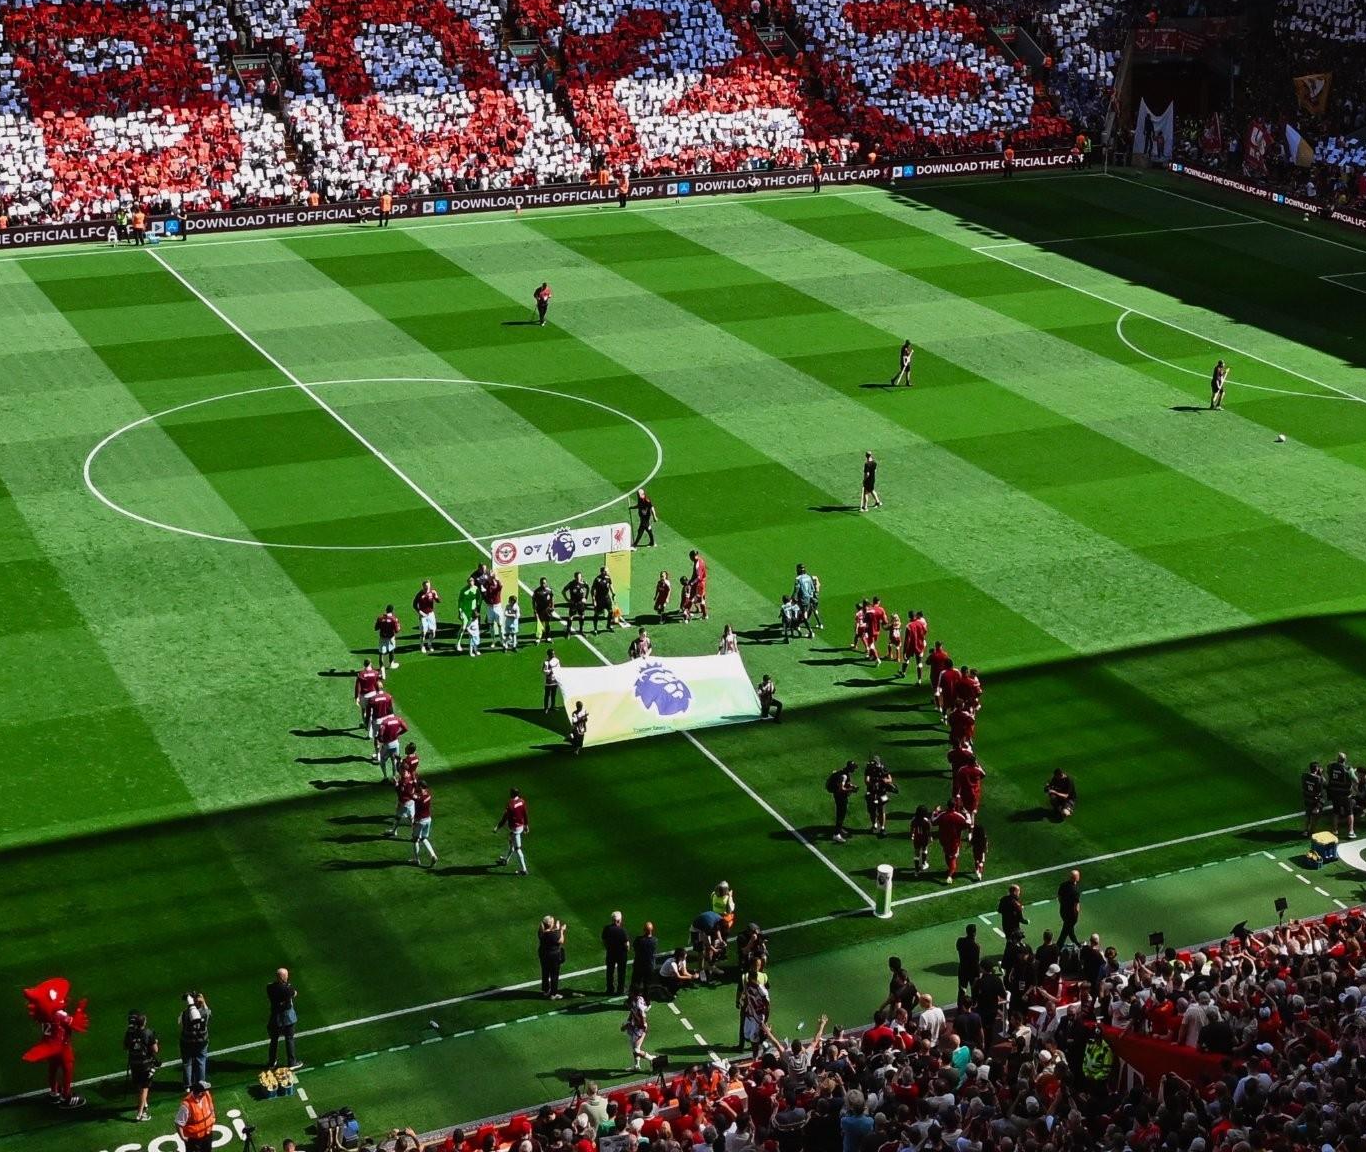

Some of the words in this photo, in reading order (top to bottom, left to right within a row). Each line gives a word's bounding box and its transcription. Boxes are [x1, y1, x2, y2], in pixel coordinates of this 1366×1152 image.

[916, 160, 982, 176] DOWNLOAD
[985, 159, 999, 170] THE
[1048, 154, 1064, 165] LFC
[764, 175, 791, 187] THE
[794, 172, 835, 185] OFFIIAL
[838, 170, 857, 182] LFC
[859, 168, 880, 180] APP
[1184, 167, 1213, 182] DOWNLOAD
[1213, 175, 1223, 184] THE
[1223, 178, 1246, 191] OFFICIAL
[1245, 184, 1256, 194] LFC
[1256, 187, 1267, 197] APP
[451, 195, 523, 211] DOWNLOAD
[527, 193, 556, 205] THE
[559, 189, 605, 203] OFFICIAL
[631, 185, 653, 197] APP
[185, 214, 265, 231] DOWNLOAD
[269, 212, 300, 225] THE
[303, 208, 355, 222] OFFICIAL
[1285, 197, 1317, 213] DOWNLOAD
[1331, 211, 1356, 224] FFICIAL
[1355, 217, 1366, 228] LFC
[20, 228, 77, 243] OFFICIAL
[80, 226, 105, 239] LFC
